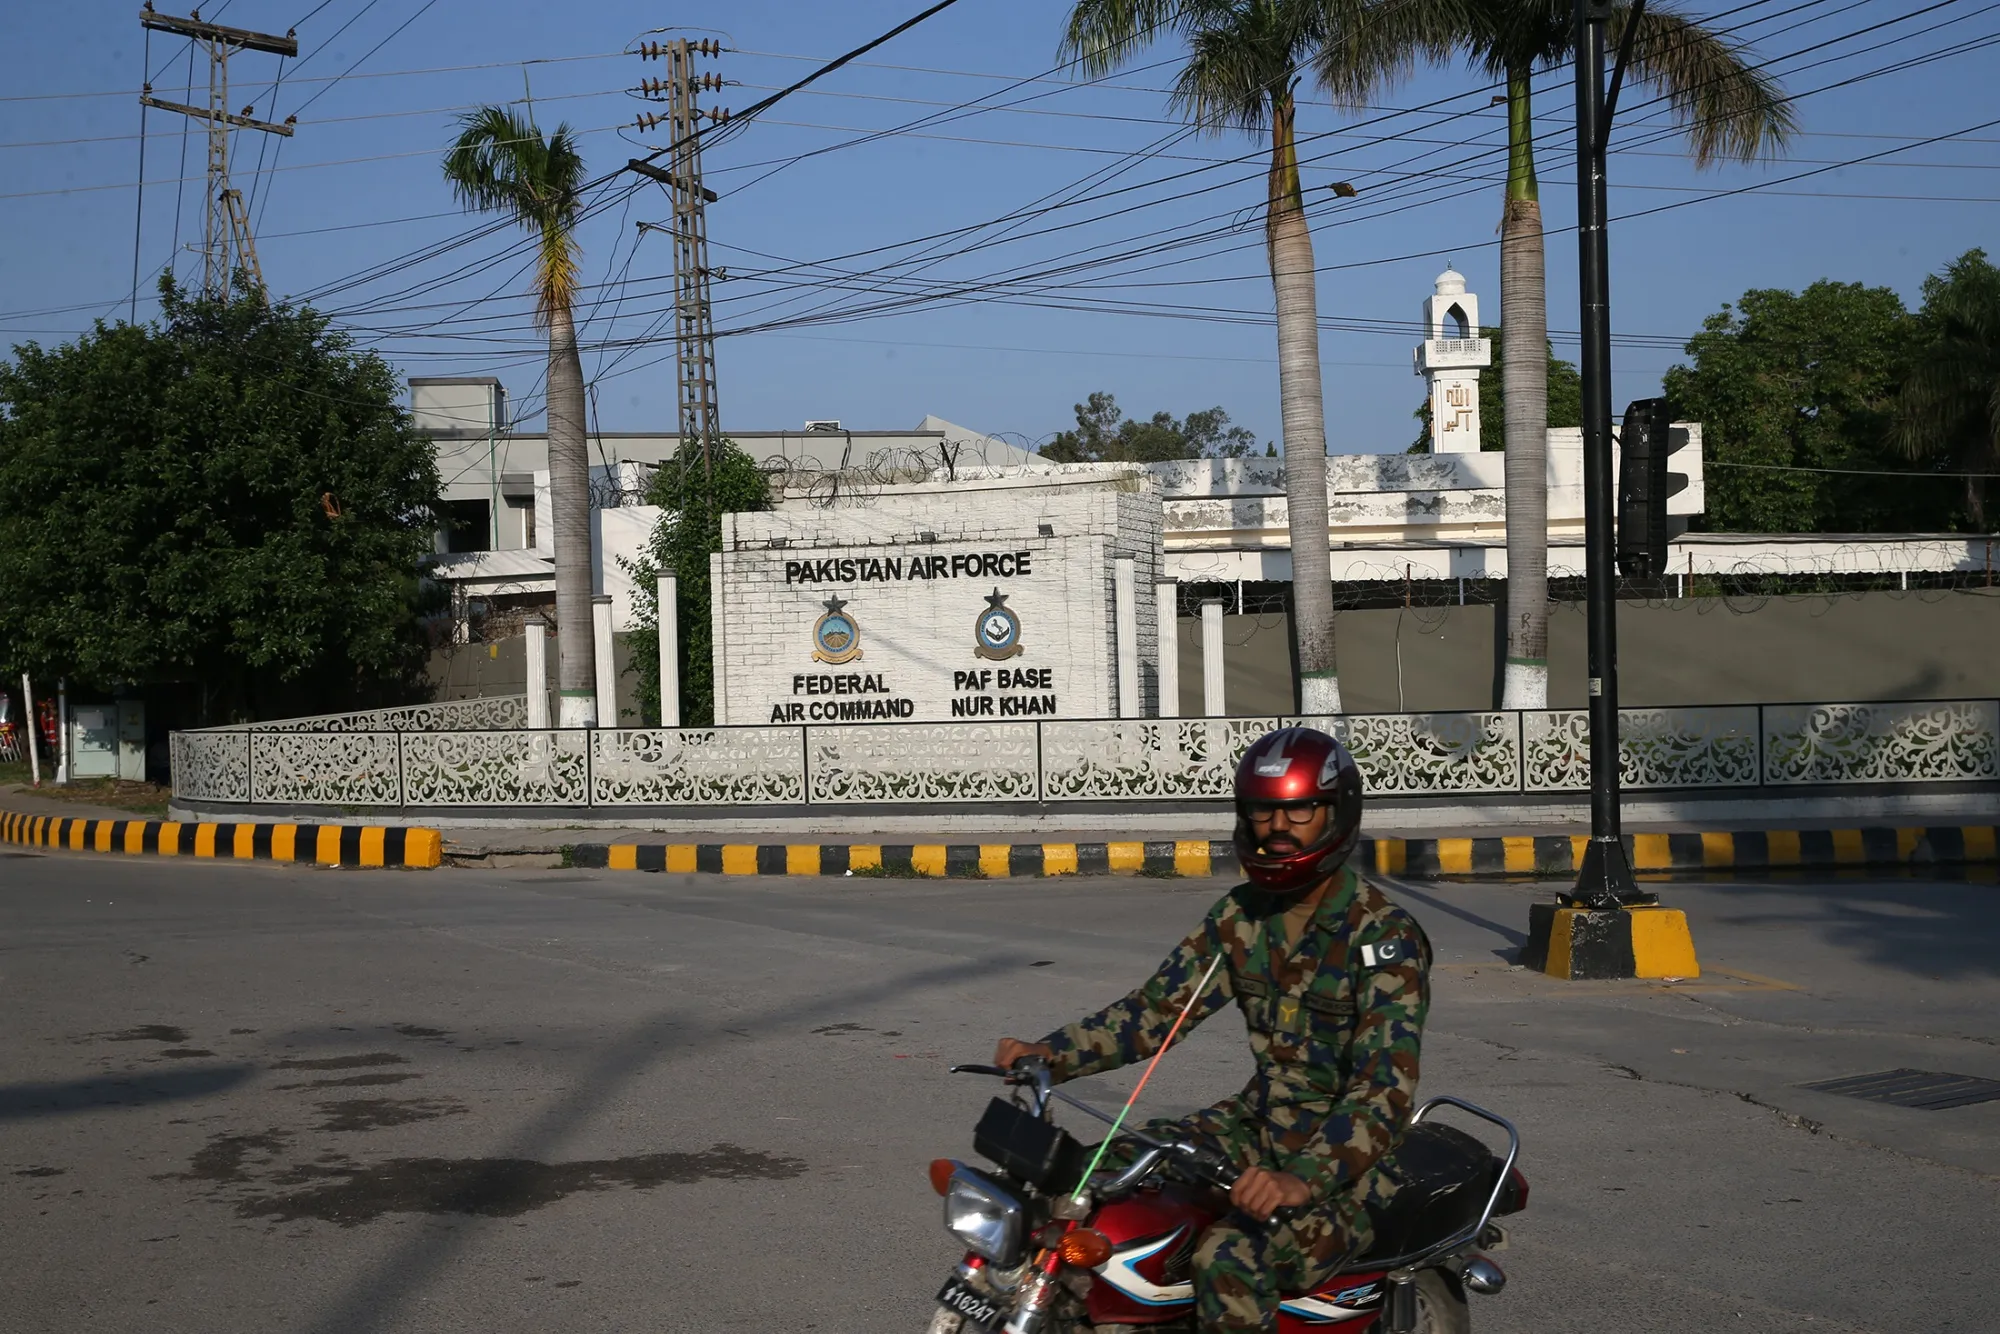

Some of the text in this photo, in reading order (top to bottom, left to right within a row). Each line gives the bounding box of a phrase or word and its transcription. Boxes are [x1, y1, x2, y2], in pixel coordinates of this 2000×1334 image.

[786, 552, 1031, 584] PAKISTAN AIR FORCE
[793, 674, 890, 695] FEDERAL
[954, 668, 1052, 691] PAF BASE
[770, 698, 914, 723] AIR COMMAND
[951, 695, 1056, 717] NUR KHAN
[952, 1291, 996, 1323] 16247
